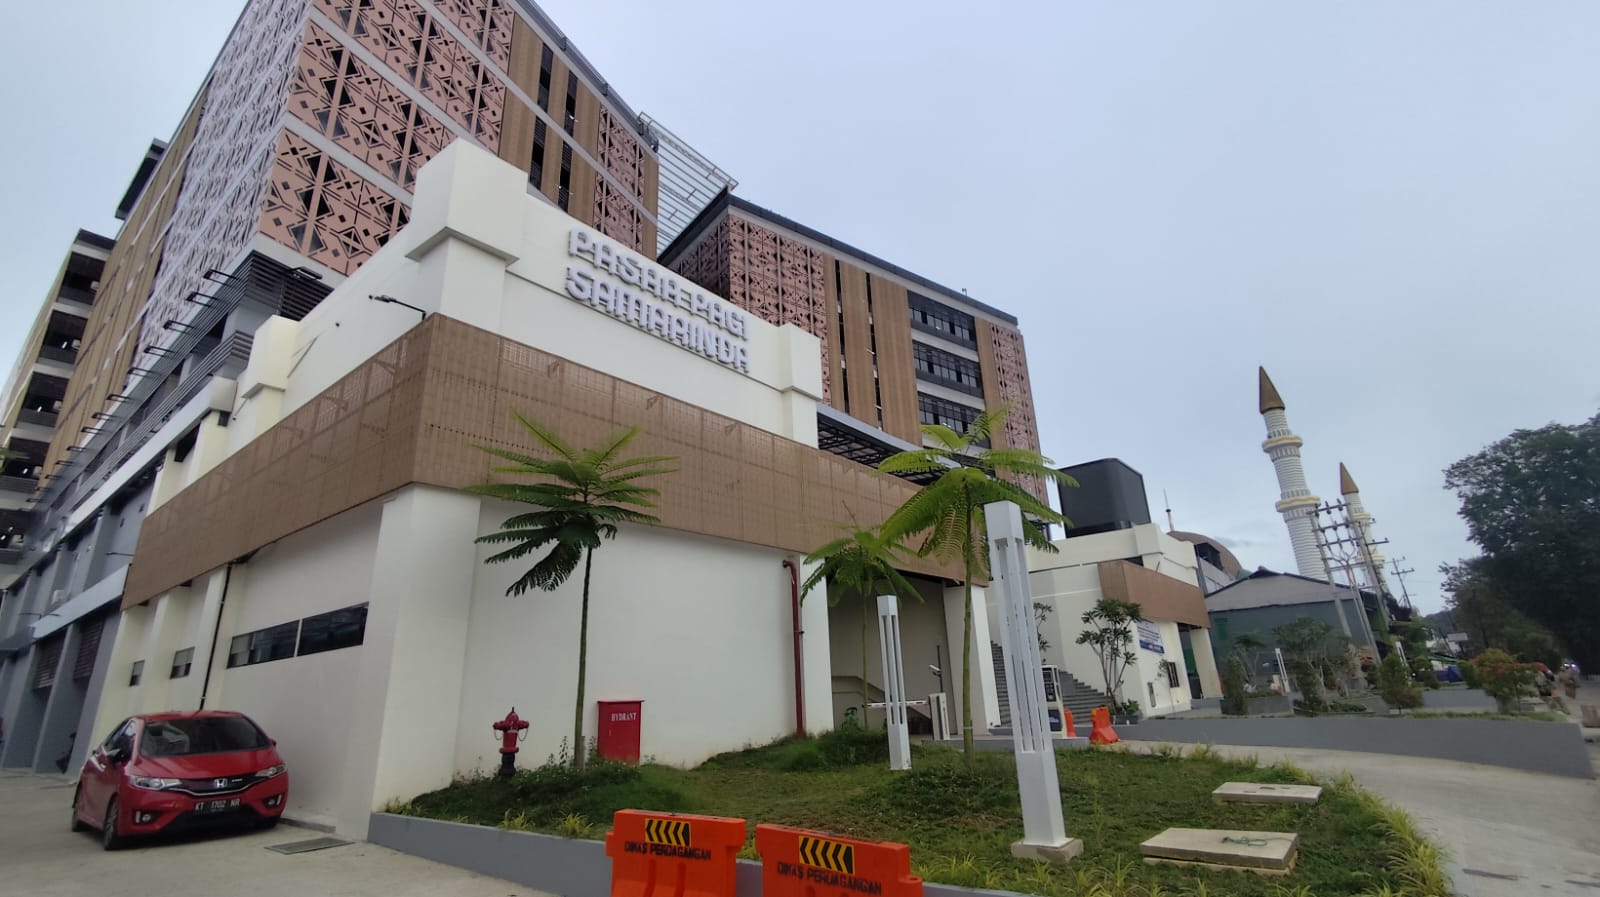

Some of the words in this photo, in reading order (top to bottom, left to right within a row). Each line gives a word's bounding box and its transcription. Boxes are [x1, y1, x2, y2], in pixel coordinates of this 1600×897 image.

[565, 265, 750, 373] SAMARINDA
[690, 289, 749, 341] PAGI
[611, 712, 637, 721] HYDRANT
